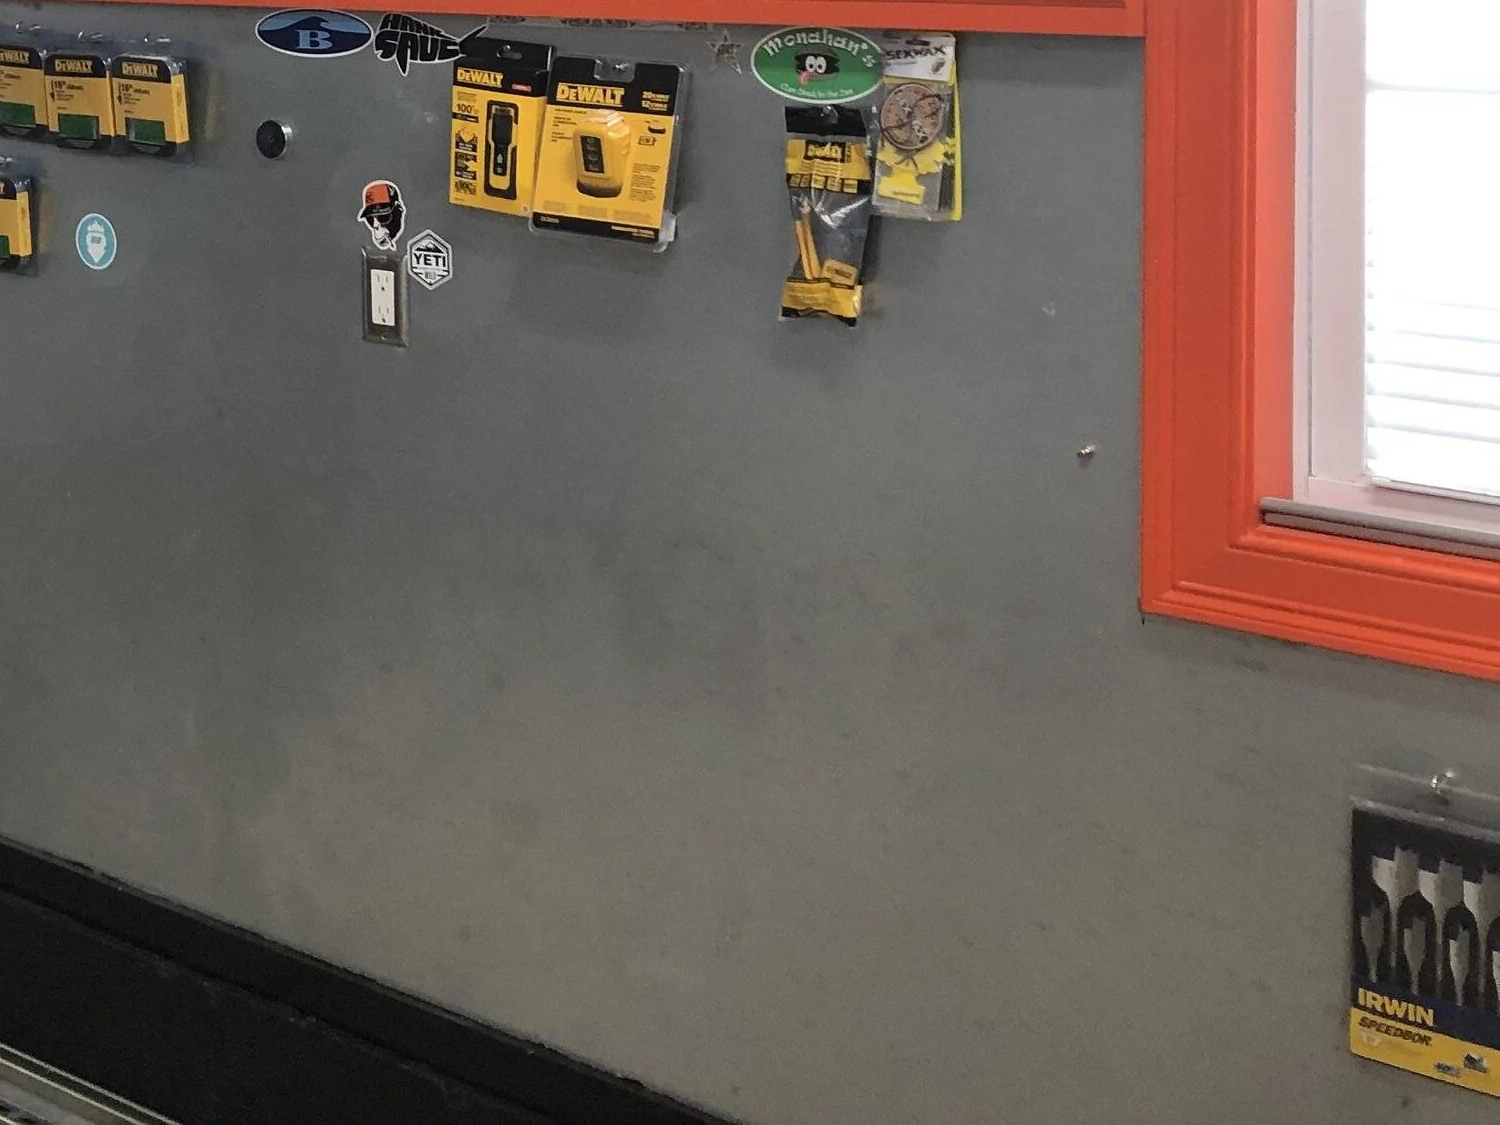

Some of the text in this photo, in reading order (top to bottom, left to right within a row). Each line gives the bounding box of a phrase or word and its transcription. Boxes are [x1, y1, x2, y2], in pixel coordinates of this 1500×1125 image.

[296, 30, 333, 50] B
[413, 252, 446, 268] YETI
[1358, 987, 1434, 1027] IRWIN
